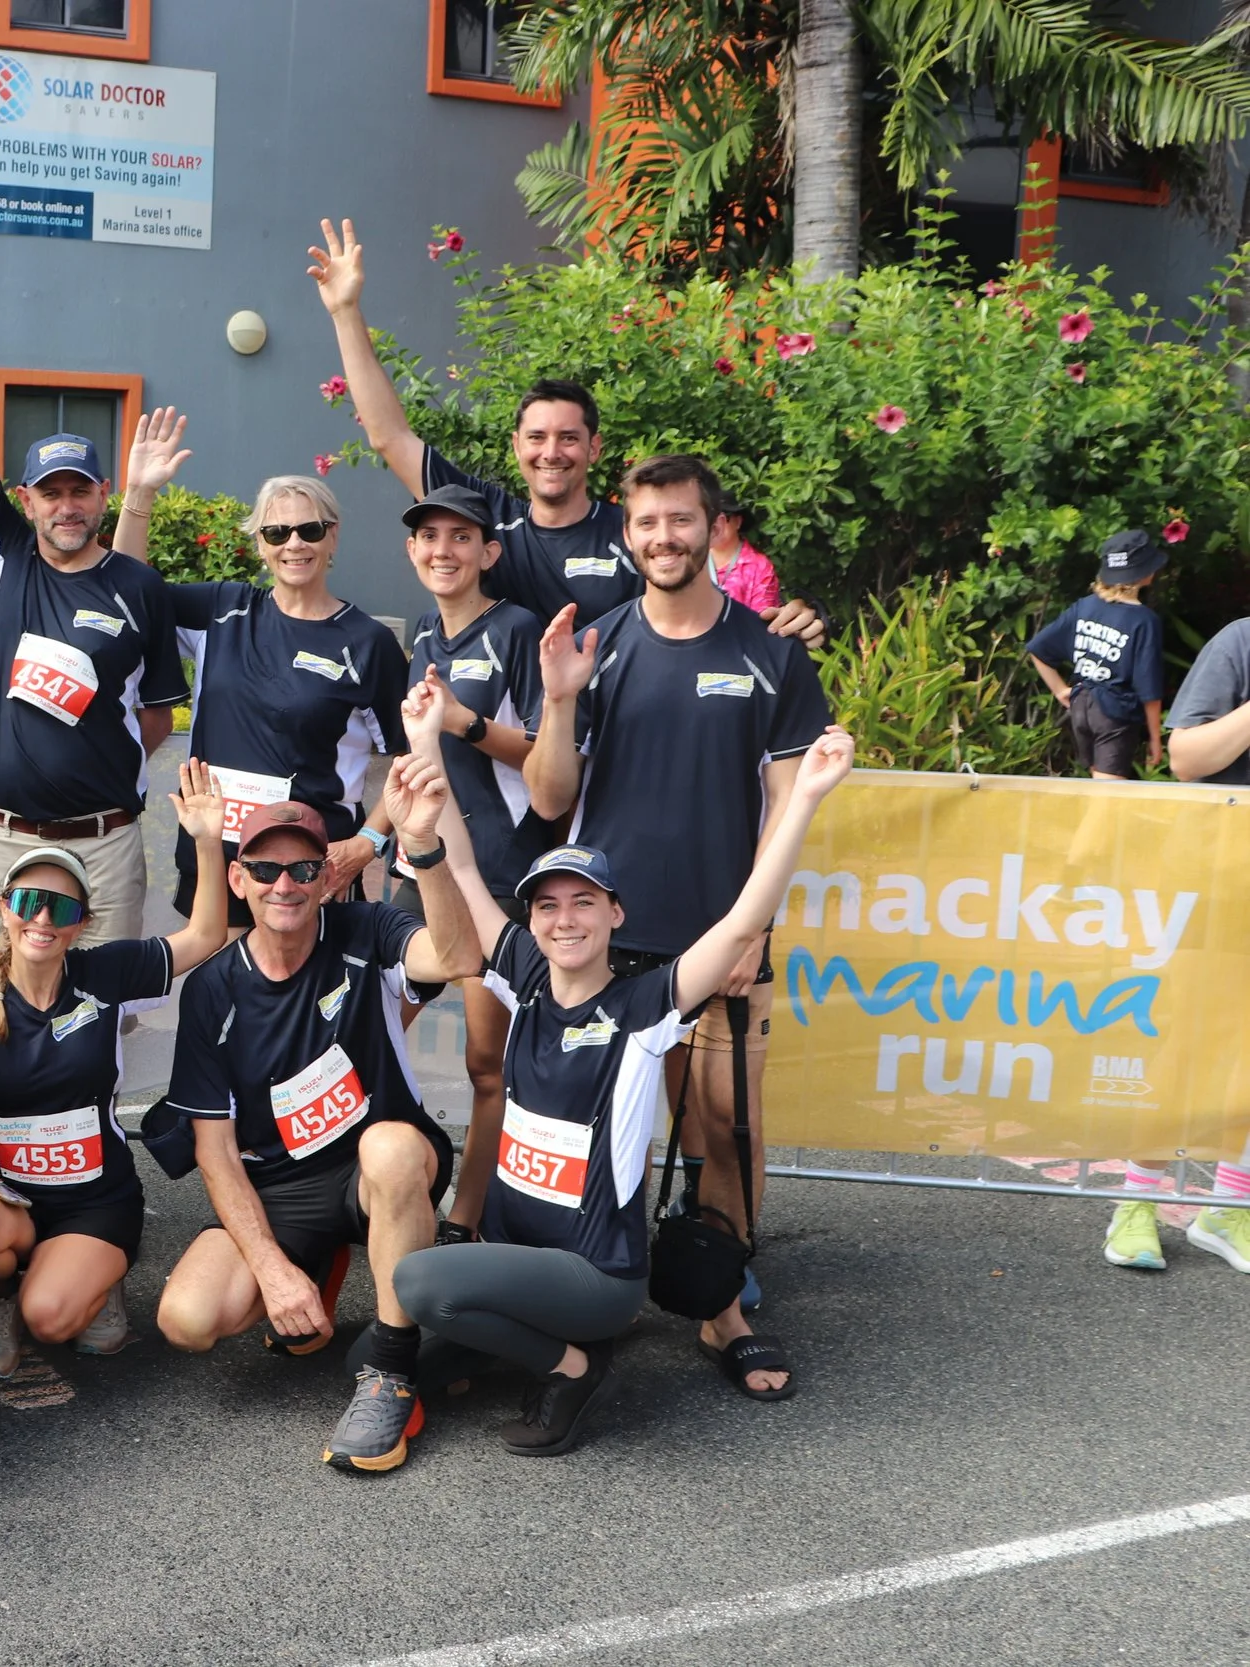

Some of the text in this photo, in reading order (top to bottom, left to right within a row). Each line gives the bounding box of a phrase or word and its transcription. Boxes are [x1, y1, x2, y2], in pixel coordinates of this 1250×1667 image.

[43, 78, 165, 107] SOLAR DOCTOR
[65, 104, 144, 121] SAVERS
[72, 145, 106, 161] WITH
[111, 149, 147, 165] YOUR
[152, 152, 202, 170] SOLAR?
[11, 159, 39, 177] help
[44, 164, 66, 178] you
[70, 166, 90, 181] get
[95, 166, 137, 186] Saving
[142, 172, 181, 188] again!
[9, 201, 19, 209] or
[21, 200, 43, 211] book
[45, 202, 73, 214] online
[74, 204, 84, 215] at
[135, 205, 172, 220] Level 1
[103, 218, 202, 238] Marina sales office
[14, 662, 80, 706] 4547
[776, 854, 1199, 969] mackay
[786, 945, 1162, 1037] marina
[875, 1034, 1055, 1102] run
[1092, 1055, 1145, 1079] BMA
[298, 1074, 323, 1094] ISUZU
[290, 1082, 357, 1140] 4545
[40, 1124, 69, 1132] ISUZU
[306, 1110, 363, 1151] Corporate Challenge
[12, 1143, 86, 1173] 4553
[506, 1142, 566, 1188] 4557
[18, 1174, 85, 1182] Corporate Challenge
